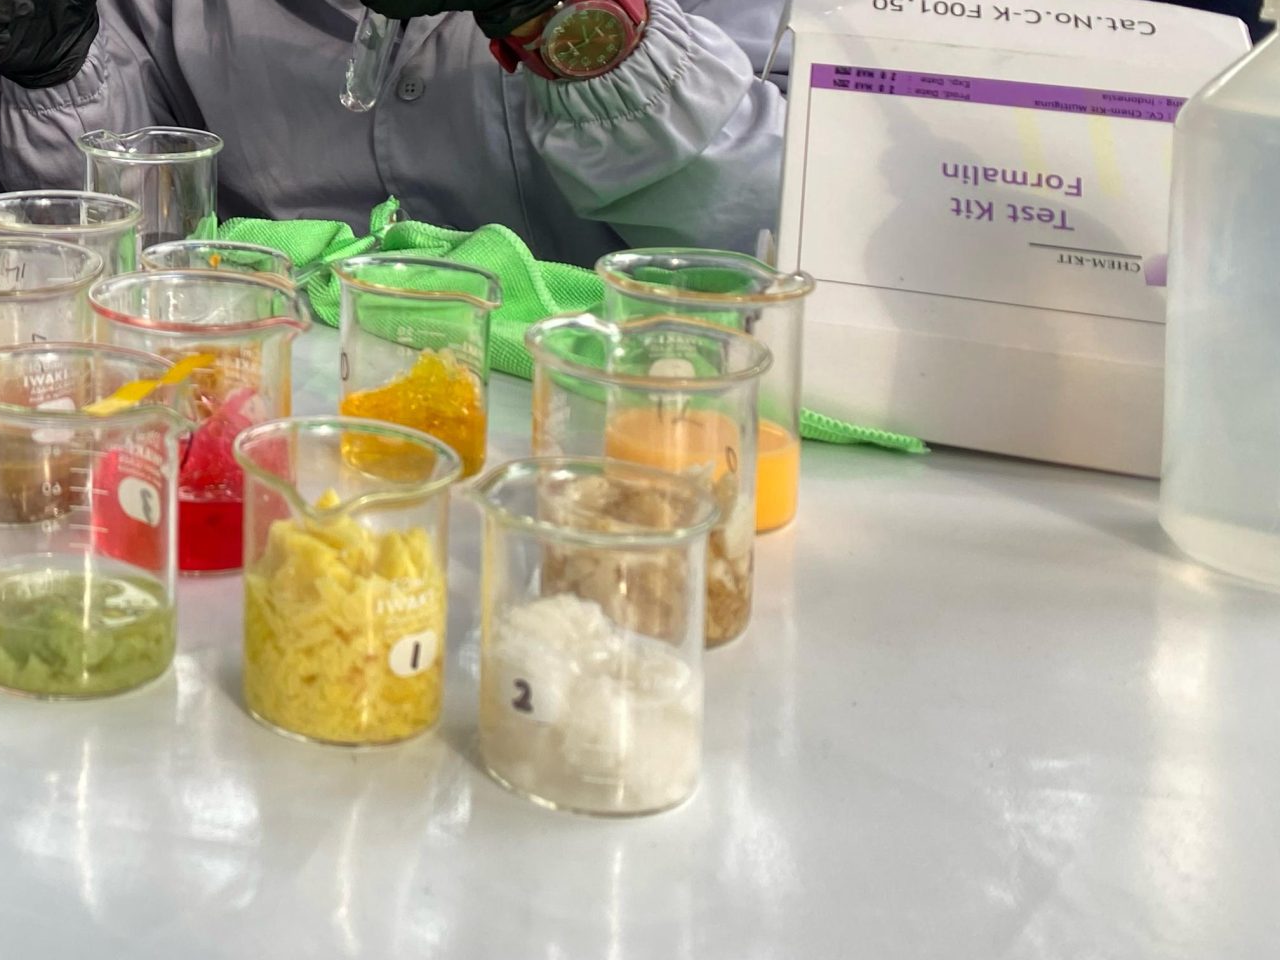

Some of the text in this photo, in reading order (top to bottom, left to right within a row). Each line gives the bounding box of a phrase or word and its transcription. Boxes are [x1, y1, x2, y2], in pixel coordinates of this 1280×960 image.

[921, 77, 944, 86] Date
[915, 89, 939, 97] Date
[1101, 93, 1155, 107] Indonesia
[1034, 100, 1087, 112] Multiguna
[1090, 106, 1142, 118] Chem-Kit
[942, 162, 1082, 197] Formalin
[950, 197, 1075, 231] Test Kit
[1057, 253, 1142, 273] CHEM-KIT
[24, 368, 68, 387] IWAKI
[410, 641, 421, 670] 1
[512, 678, 535, 714] 2
